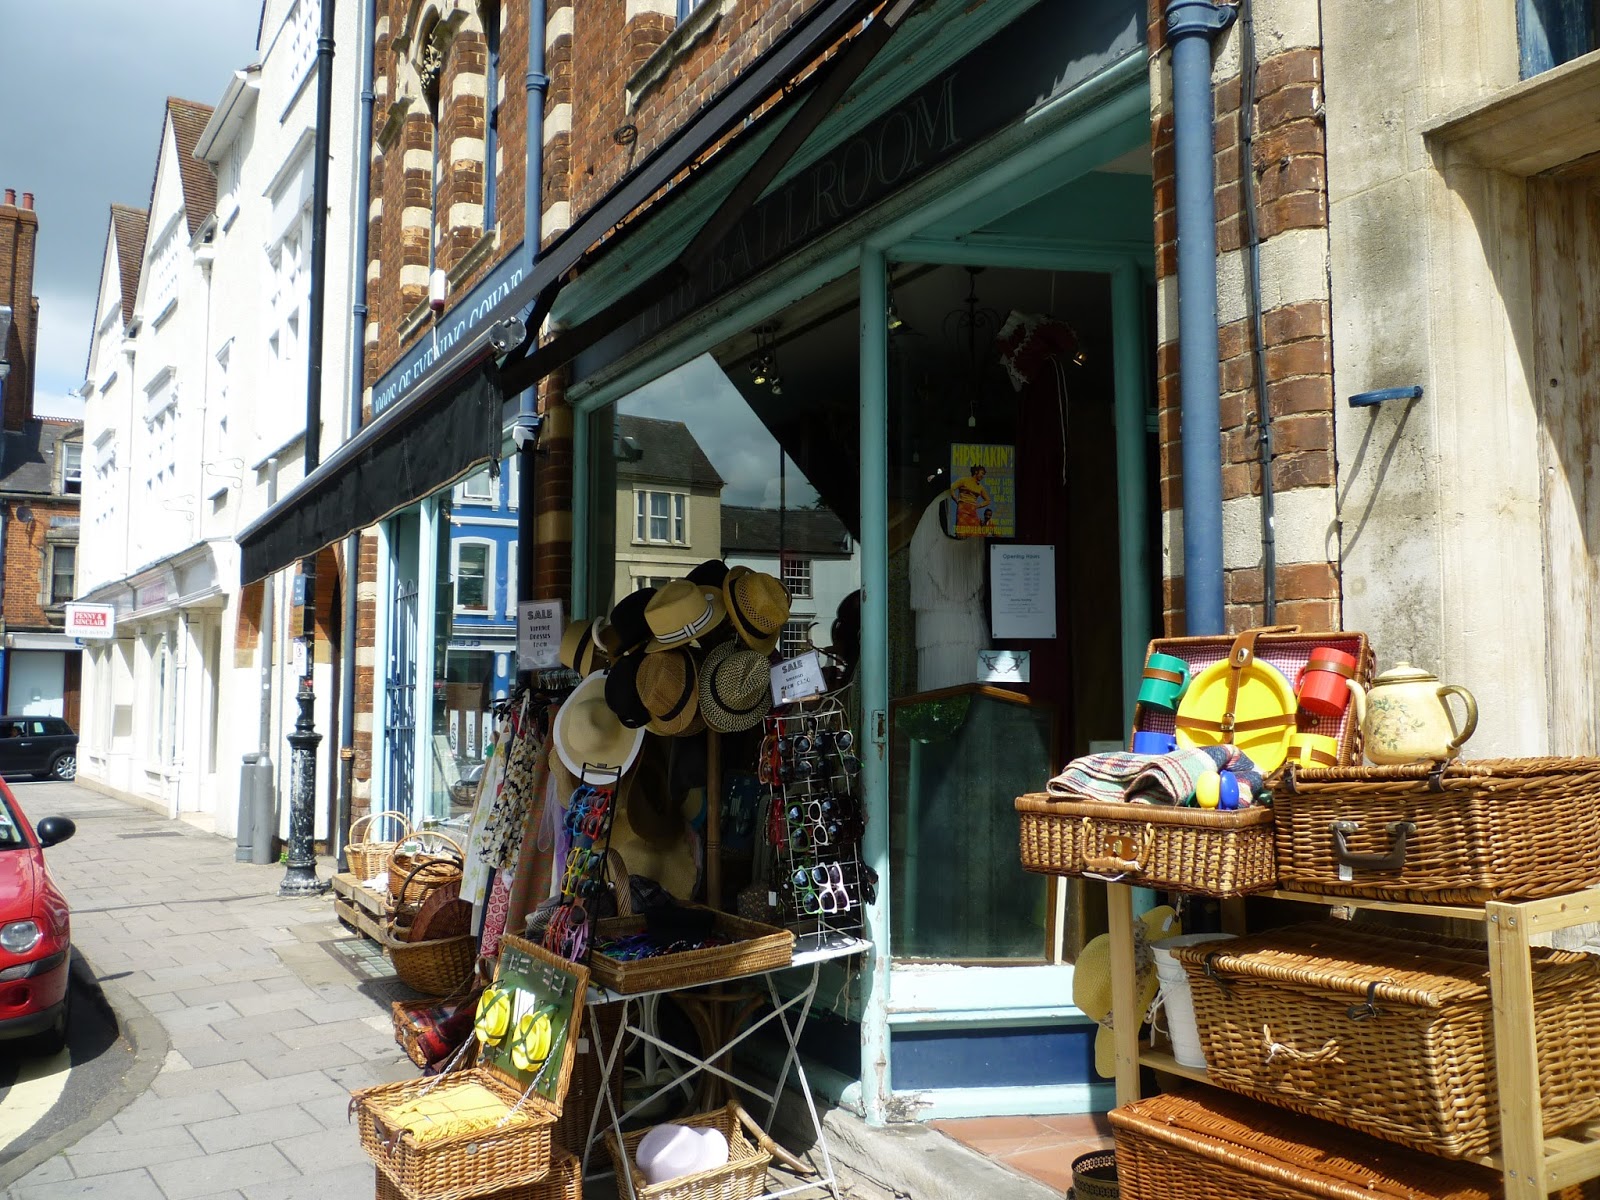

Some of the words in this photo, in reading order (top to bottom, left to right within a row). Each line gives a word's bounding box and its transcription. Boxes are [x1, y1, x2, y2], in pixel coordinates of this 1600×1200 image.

[708, 71, 963, 293] BALLROOM
[75, 612, 96, 620] PENNY
[527, 609, 553, 620] SALE
[782, 660, 803, 674] SALE
